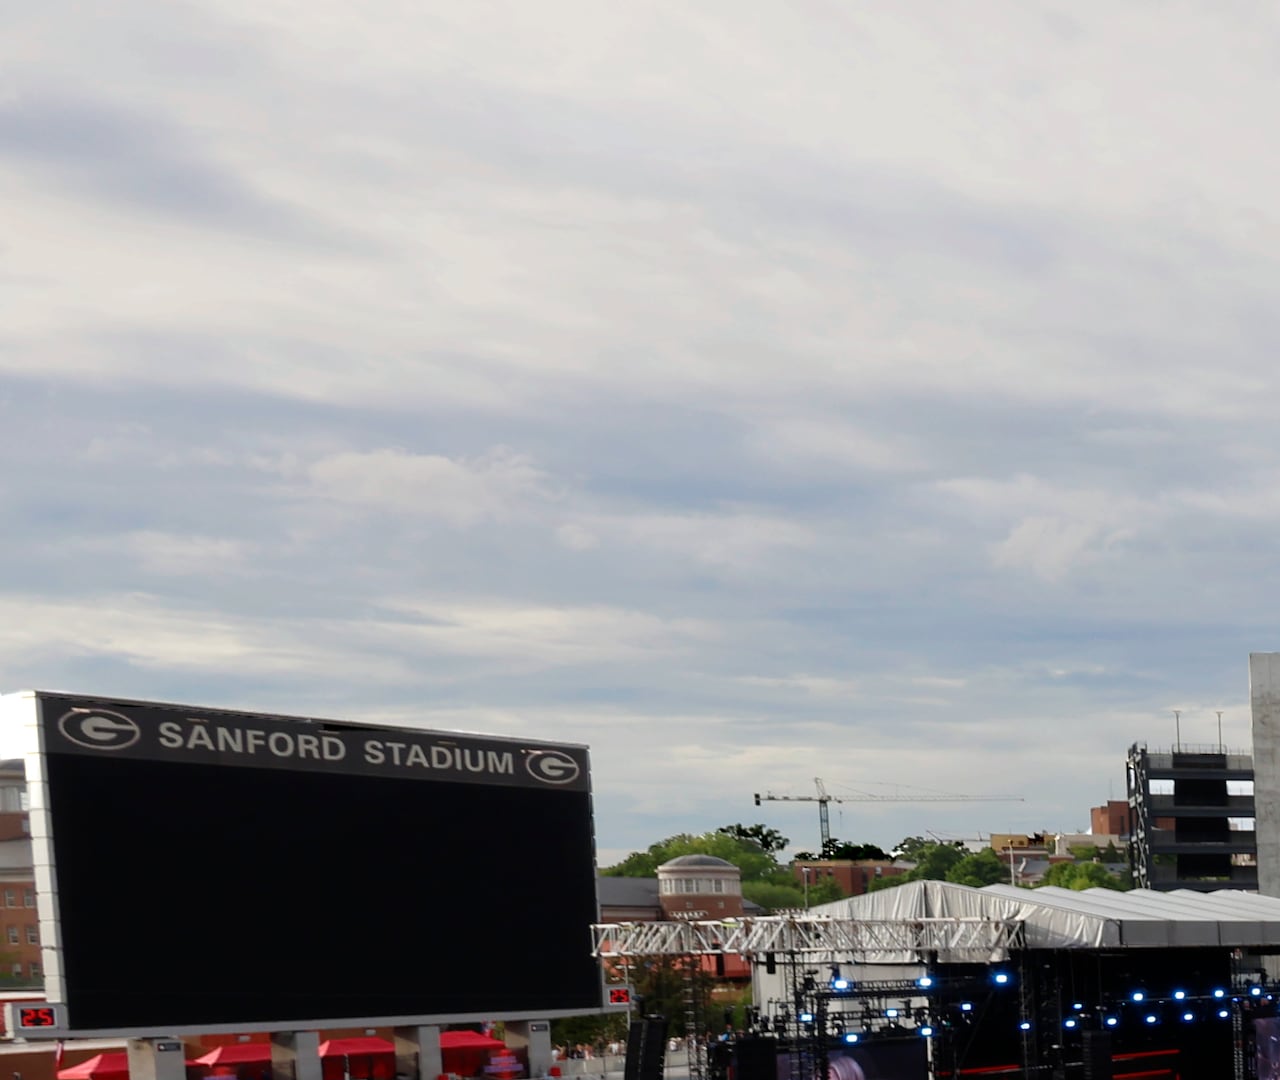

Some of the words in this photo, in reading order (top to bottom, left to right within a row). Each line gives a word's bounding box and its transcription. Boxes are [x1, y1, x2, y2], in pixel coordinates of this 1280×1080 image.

[159, 722, 346, 762] SANFORD
[364, 740, 515, 775] STADIUM
[611, 989, 629, 1003] 25
[22, 1008, 53, 1026] 25
